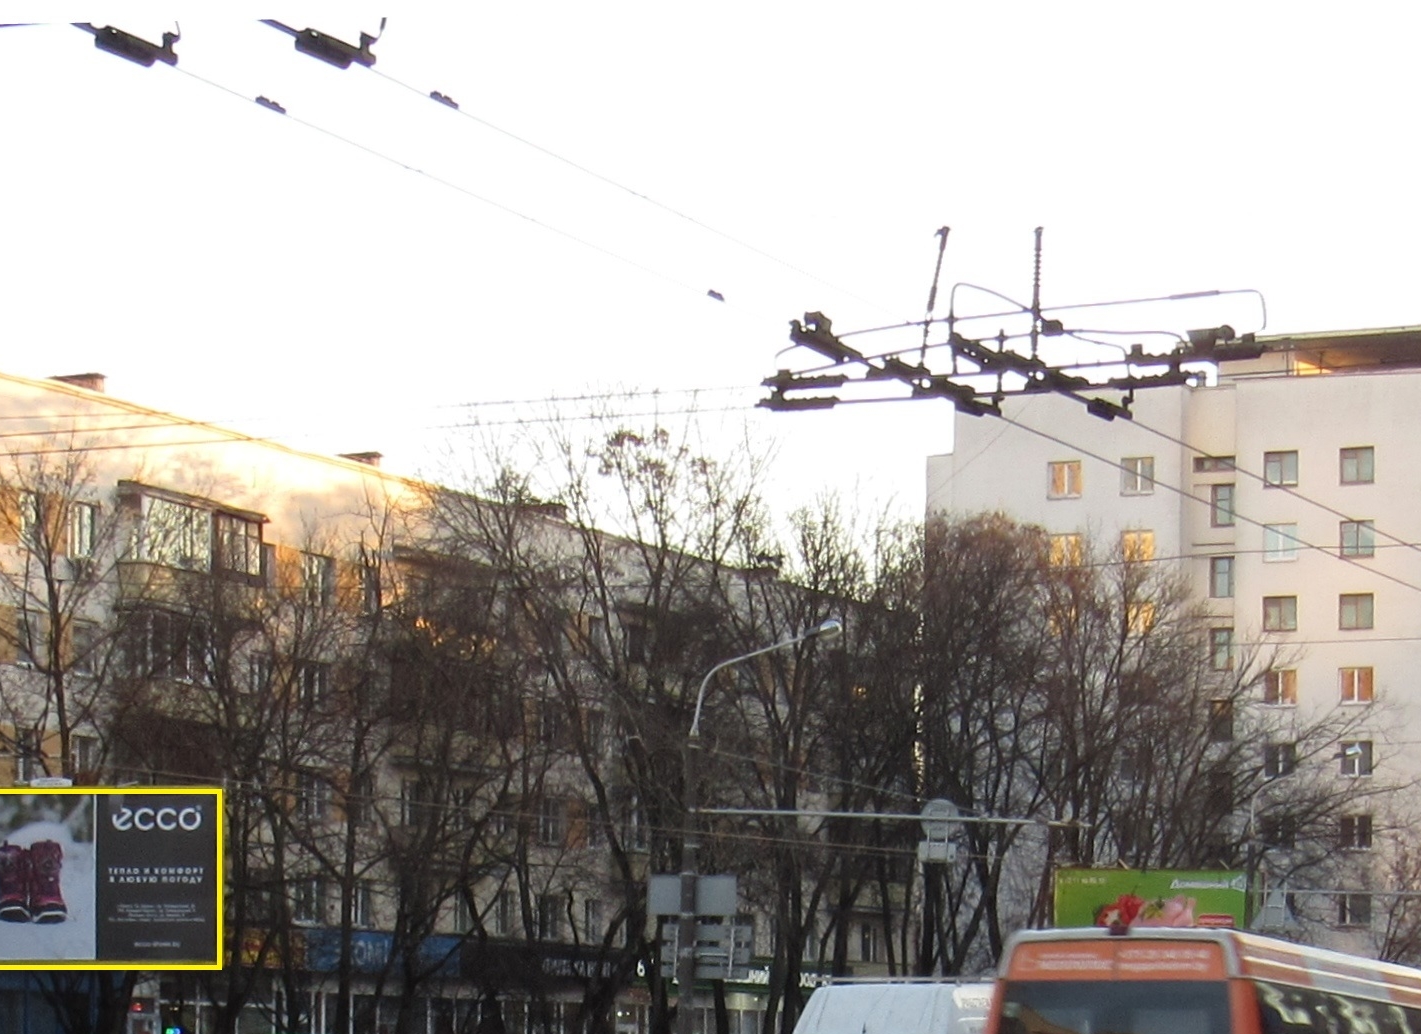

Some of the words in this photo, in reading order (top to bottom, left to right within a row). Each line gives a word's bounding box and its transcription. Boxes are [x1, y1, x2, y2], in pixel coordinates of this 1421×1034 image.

[112, 804, 202, 831] ecco
[108, 867, 139, 875] ТЕПЛО
[144, 867, 150, 875] И
[154, 867, 204, 875] КОМФОРТ
[162, 876, 203, 884] ПОГОДУ
